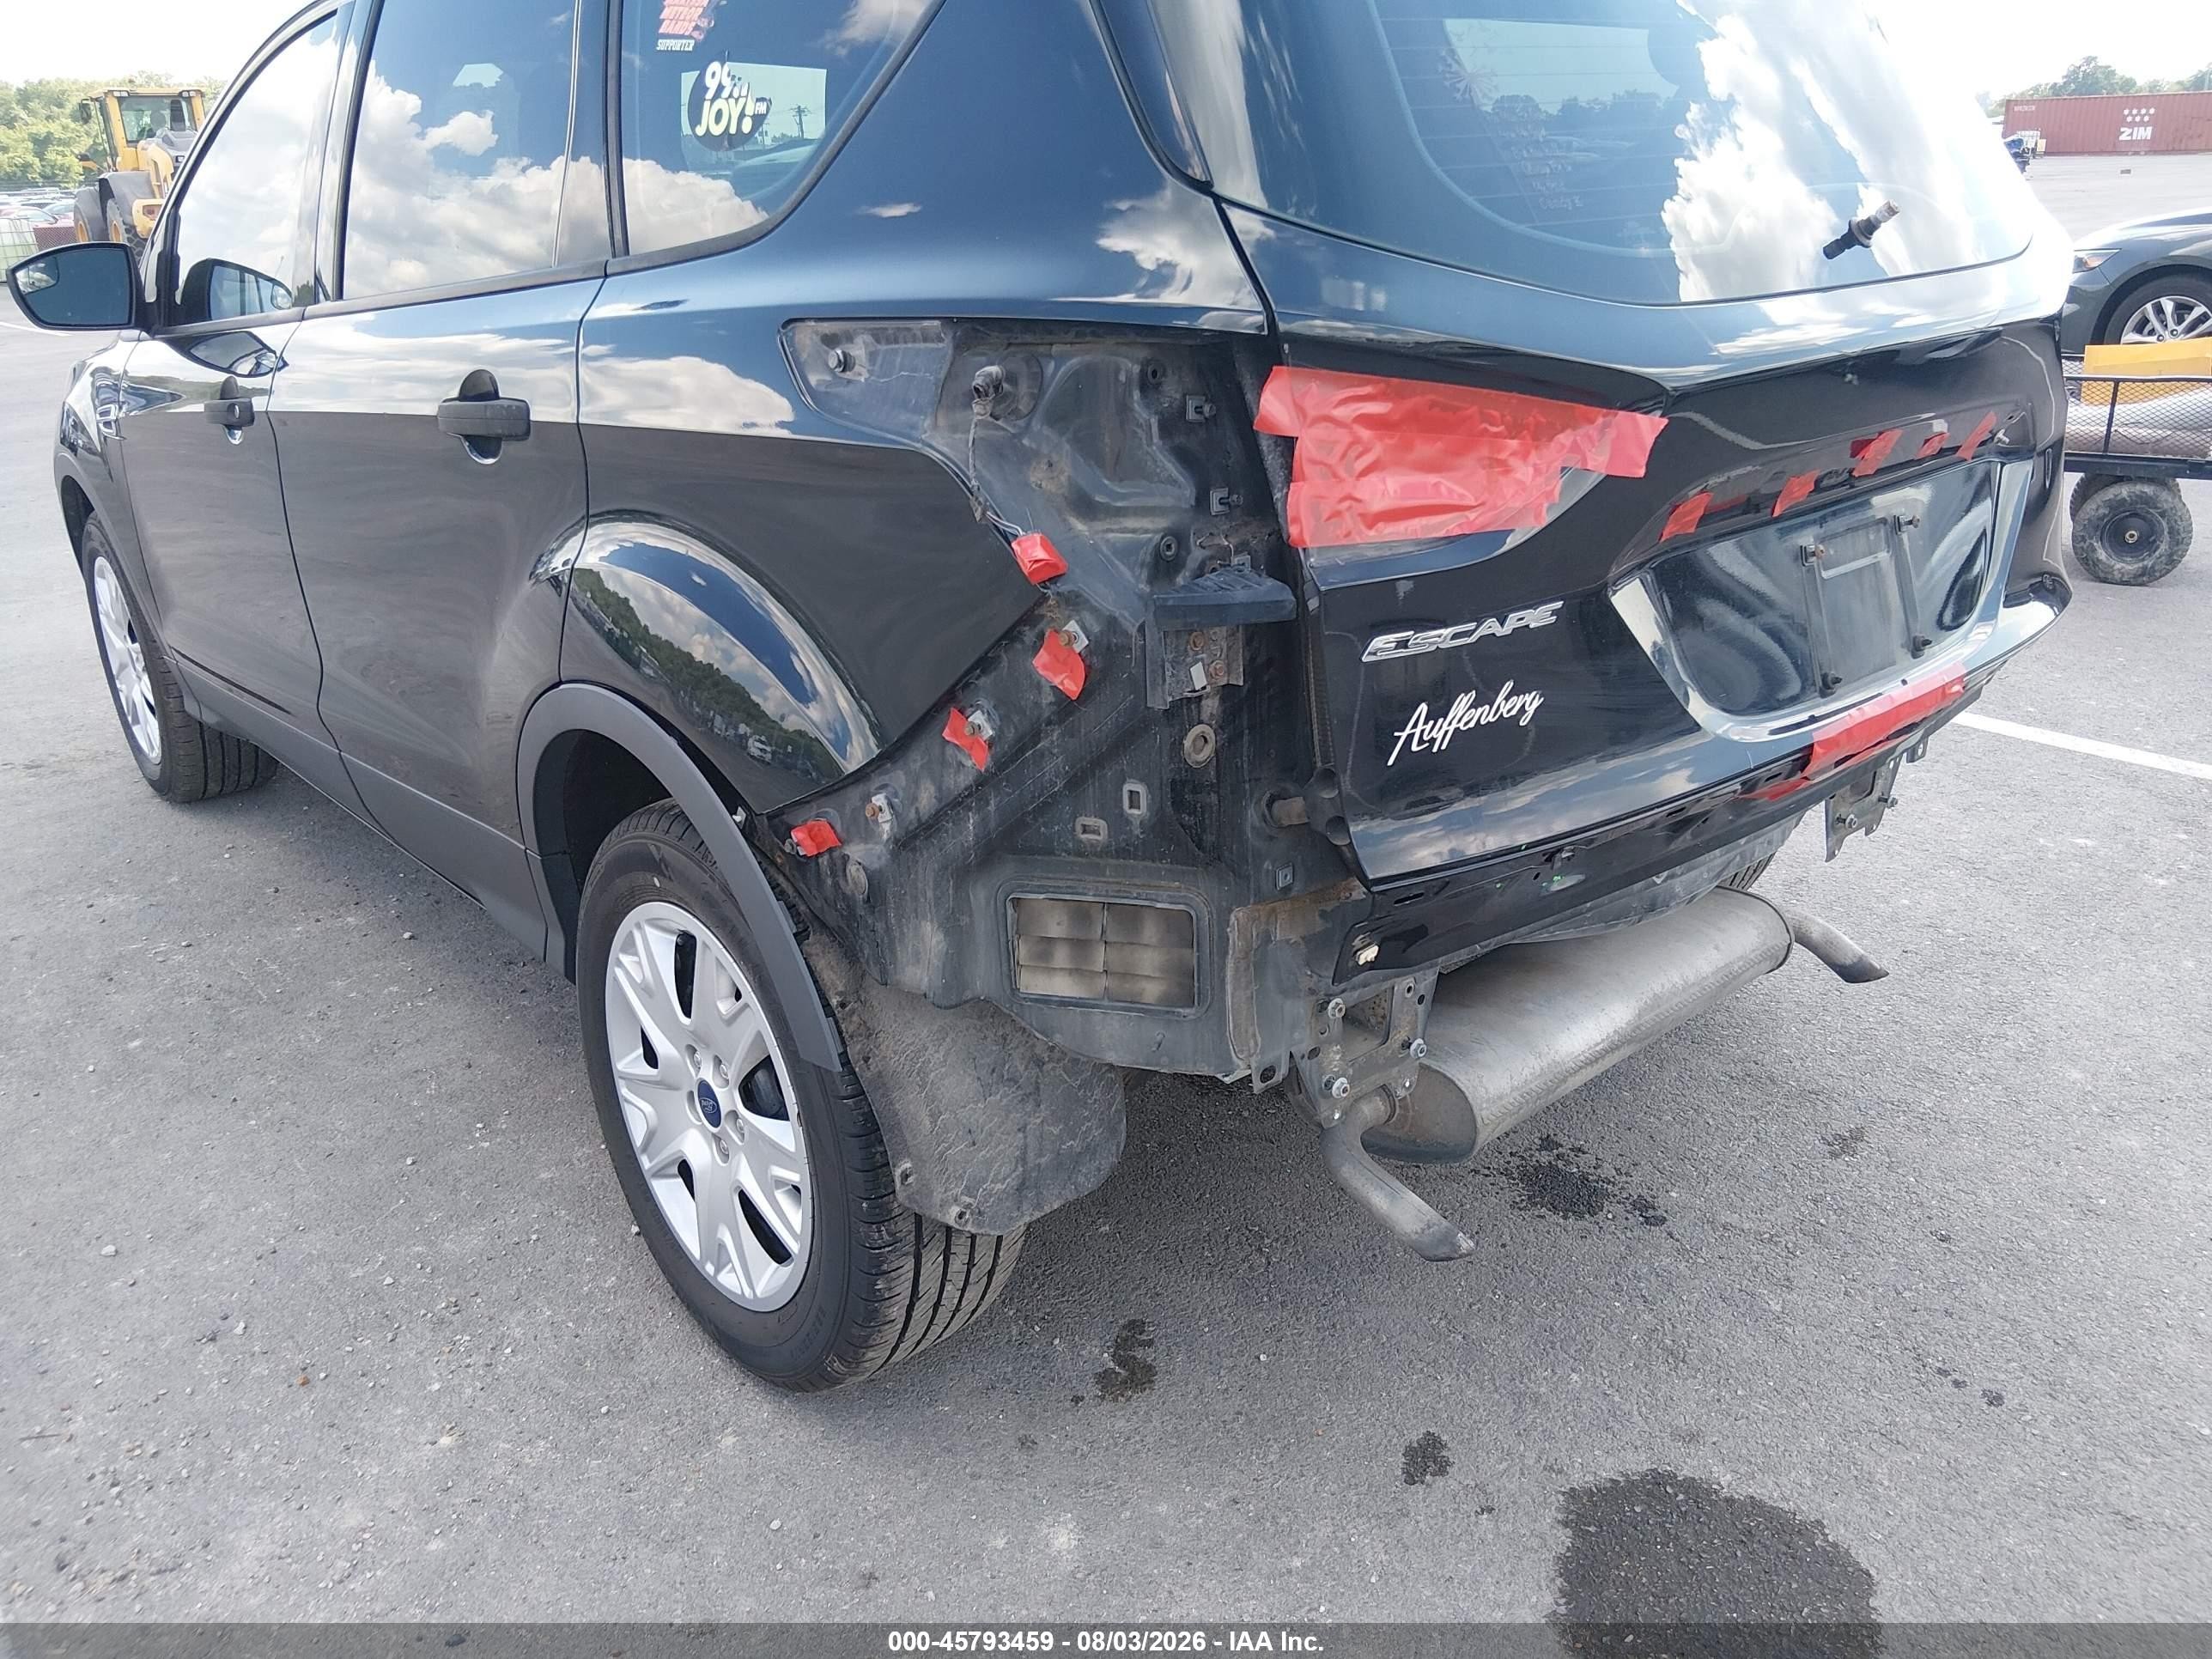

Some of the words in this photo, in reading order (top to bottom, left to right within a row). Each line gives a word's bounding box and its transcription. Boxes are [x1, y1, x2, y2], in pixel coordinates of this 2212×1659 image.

[656, 40, 695, 52] SUPPORTER
[755, 101, 767, 114] FM
[2118, 126, 2153, 141] ZIM
[1361, 601, 1565, 662] ESCAPE
[1386, 679, 1544, 766] Auffenberg
